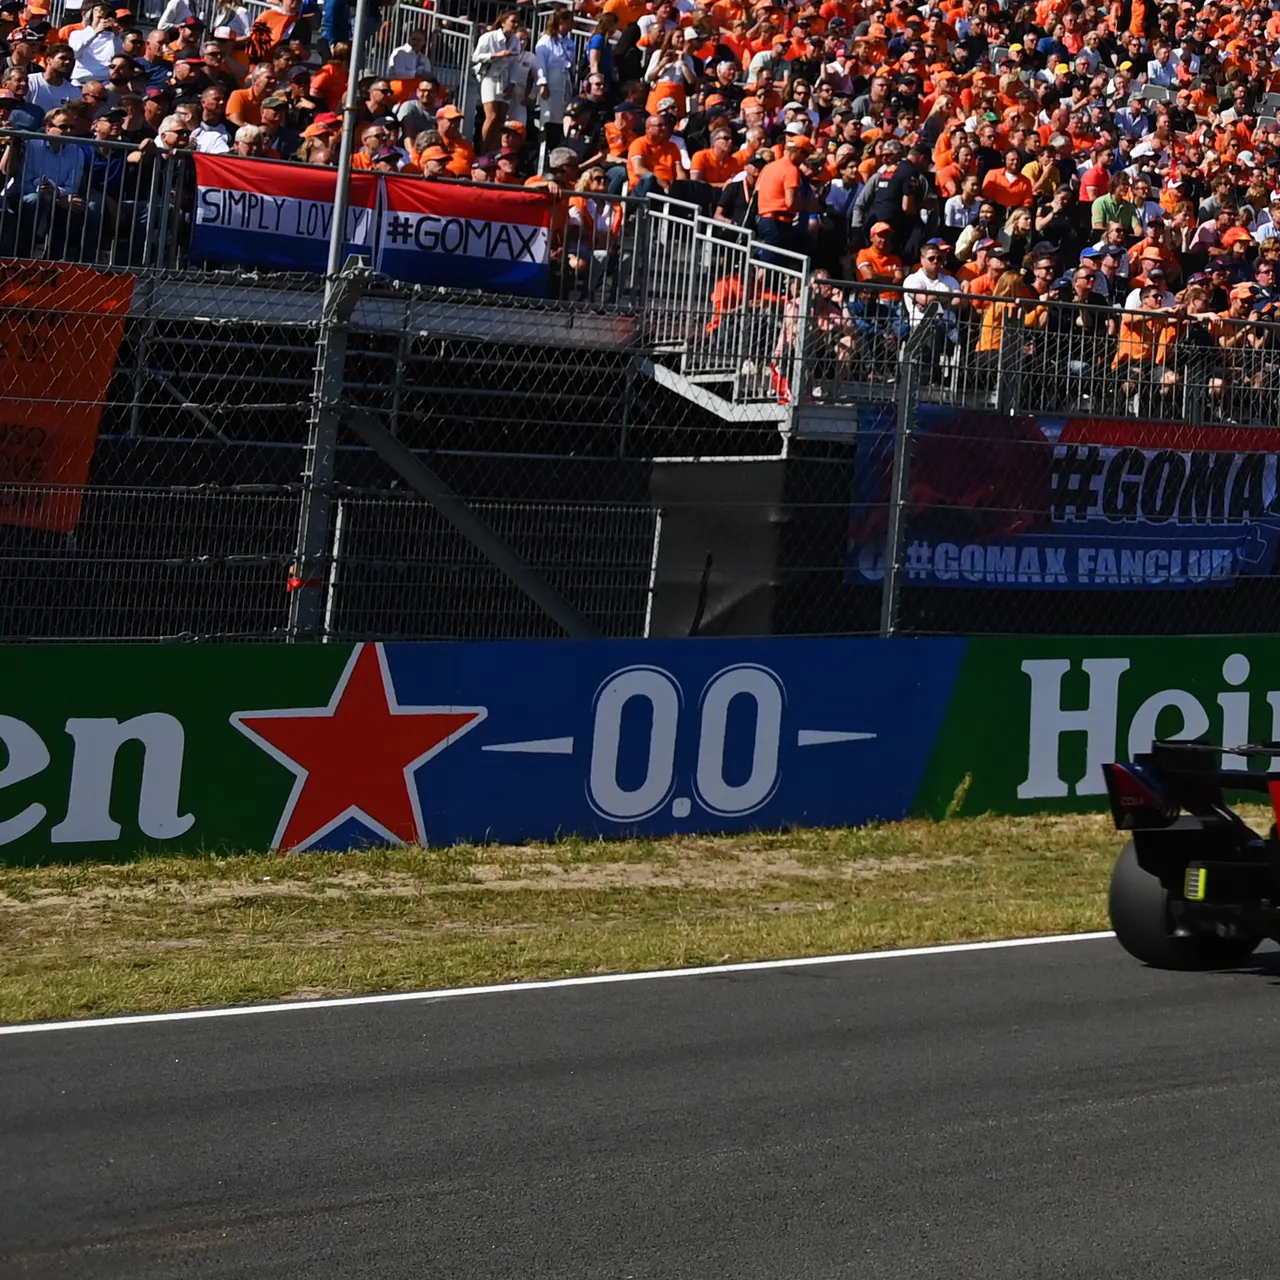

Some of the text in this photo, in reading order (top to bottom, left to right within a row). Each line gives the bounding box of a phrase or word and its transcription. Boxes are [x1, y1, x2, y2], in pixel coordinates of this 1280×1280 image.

[202, 187, 370, 244] SIMPLY LOVLY!
[906, 539, 1069, 584] #GOMAX
[1077, 545, 1236, 584] FANCLUB
[586, 663, 787, 821] 0.0
